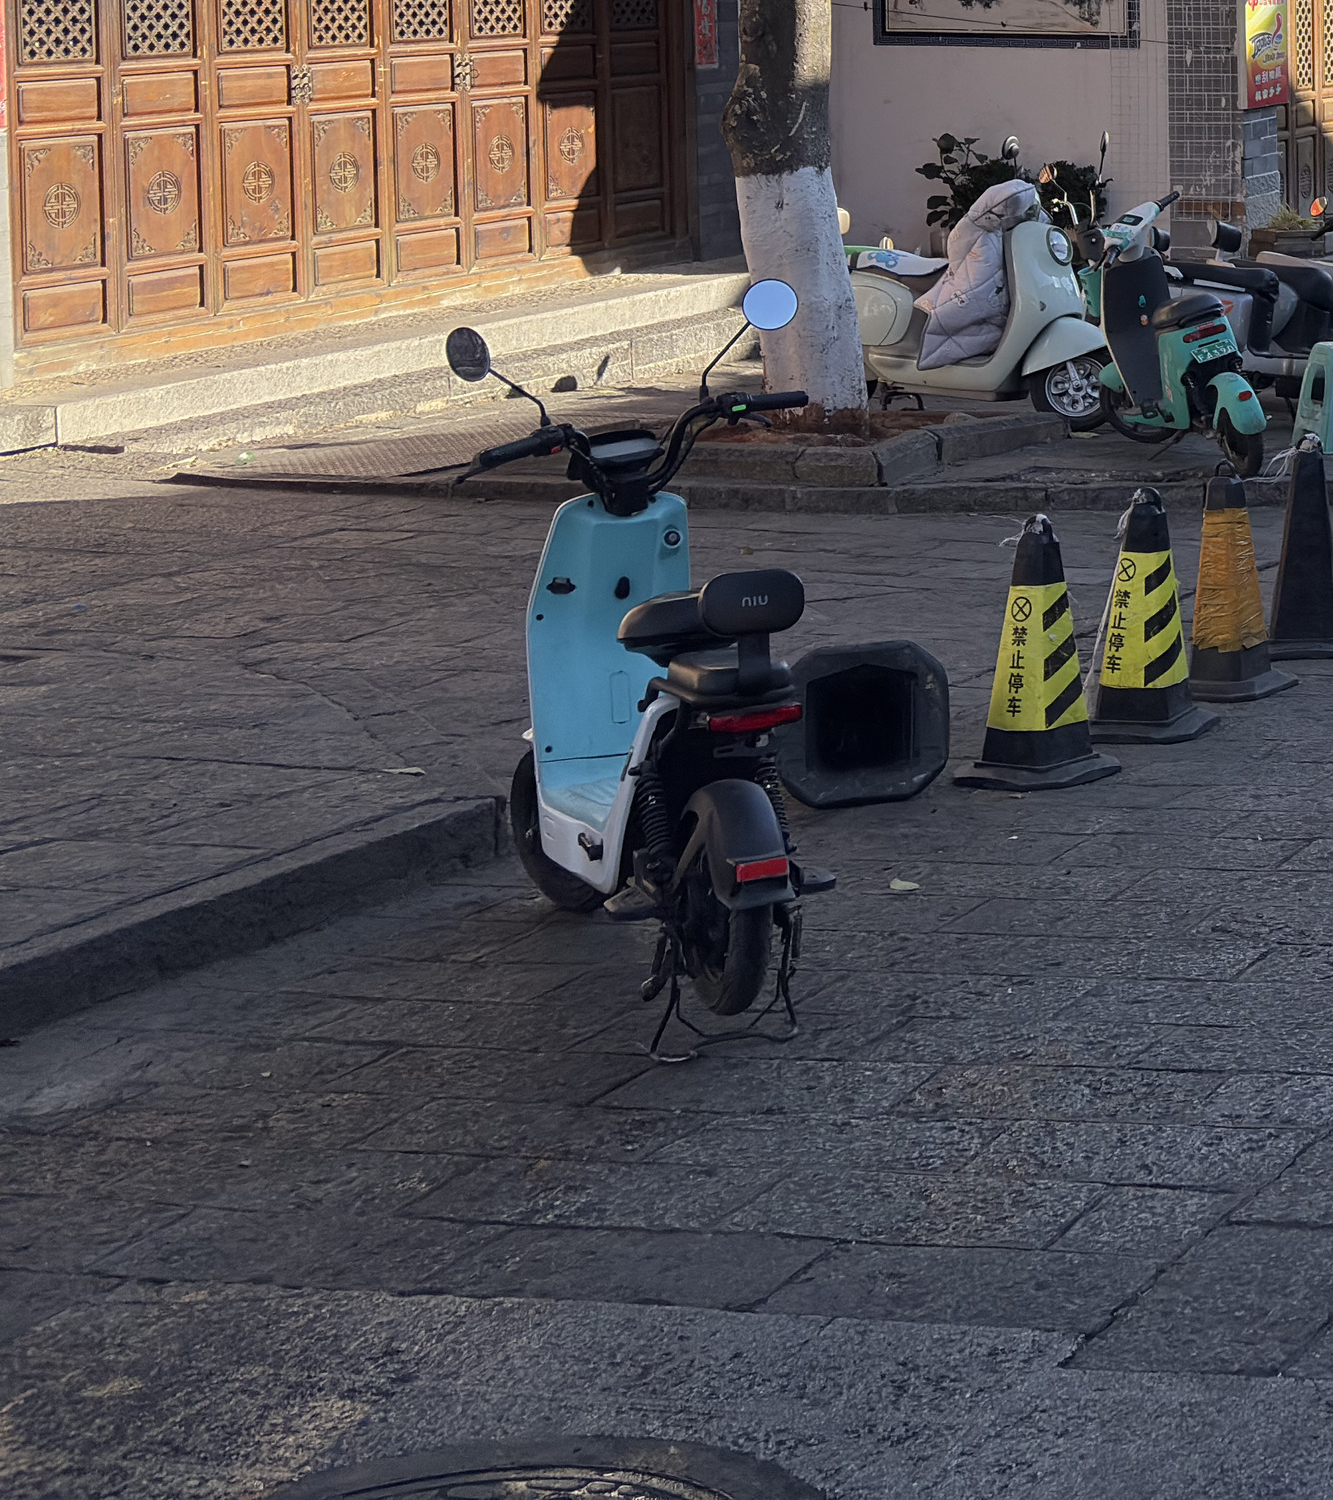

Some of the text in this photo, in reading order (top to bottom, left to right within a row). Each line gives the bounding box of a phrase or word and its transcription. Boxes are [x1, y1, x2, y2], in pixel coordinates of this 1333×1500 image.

[1006, 626, 1028, 718] 禁止停车
[1105, 589, 1132, 674] 禁止停车
